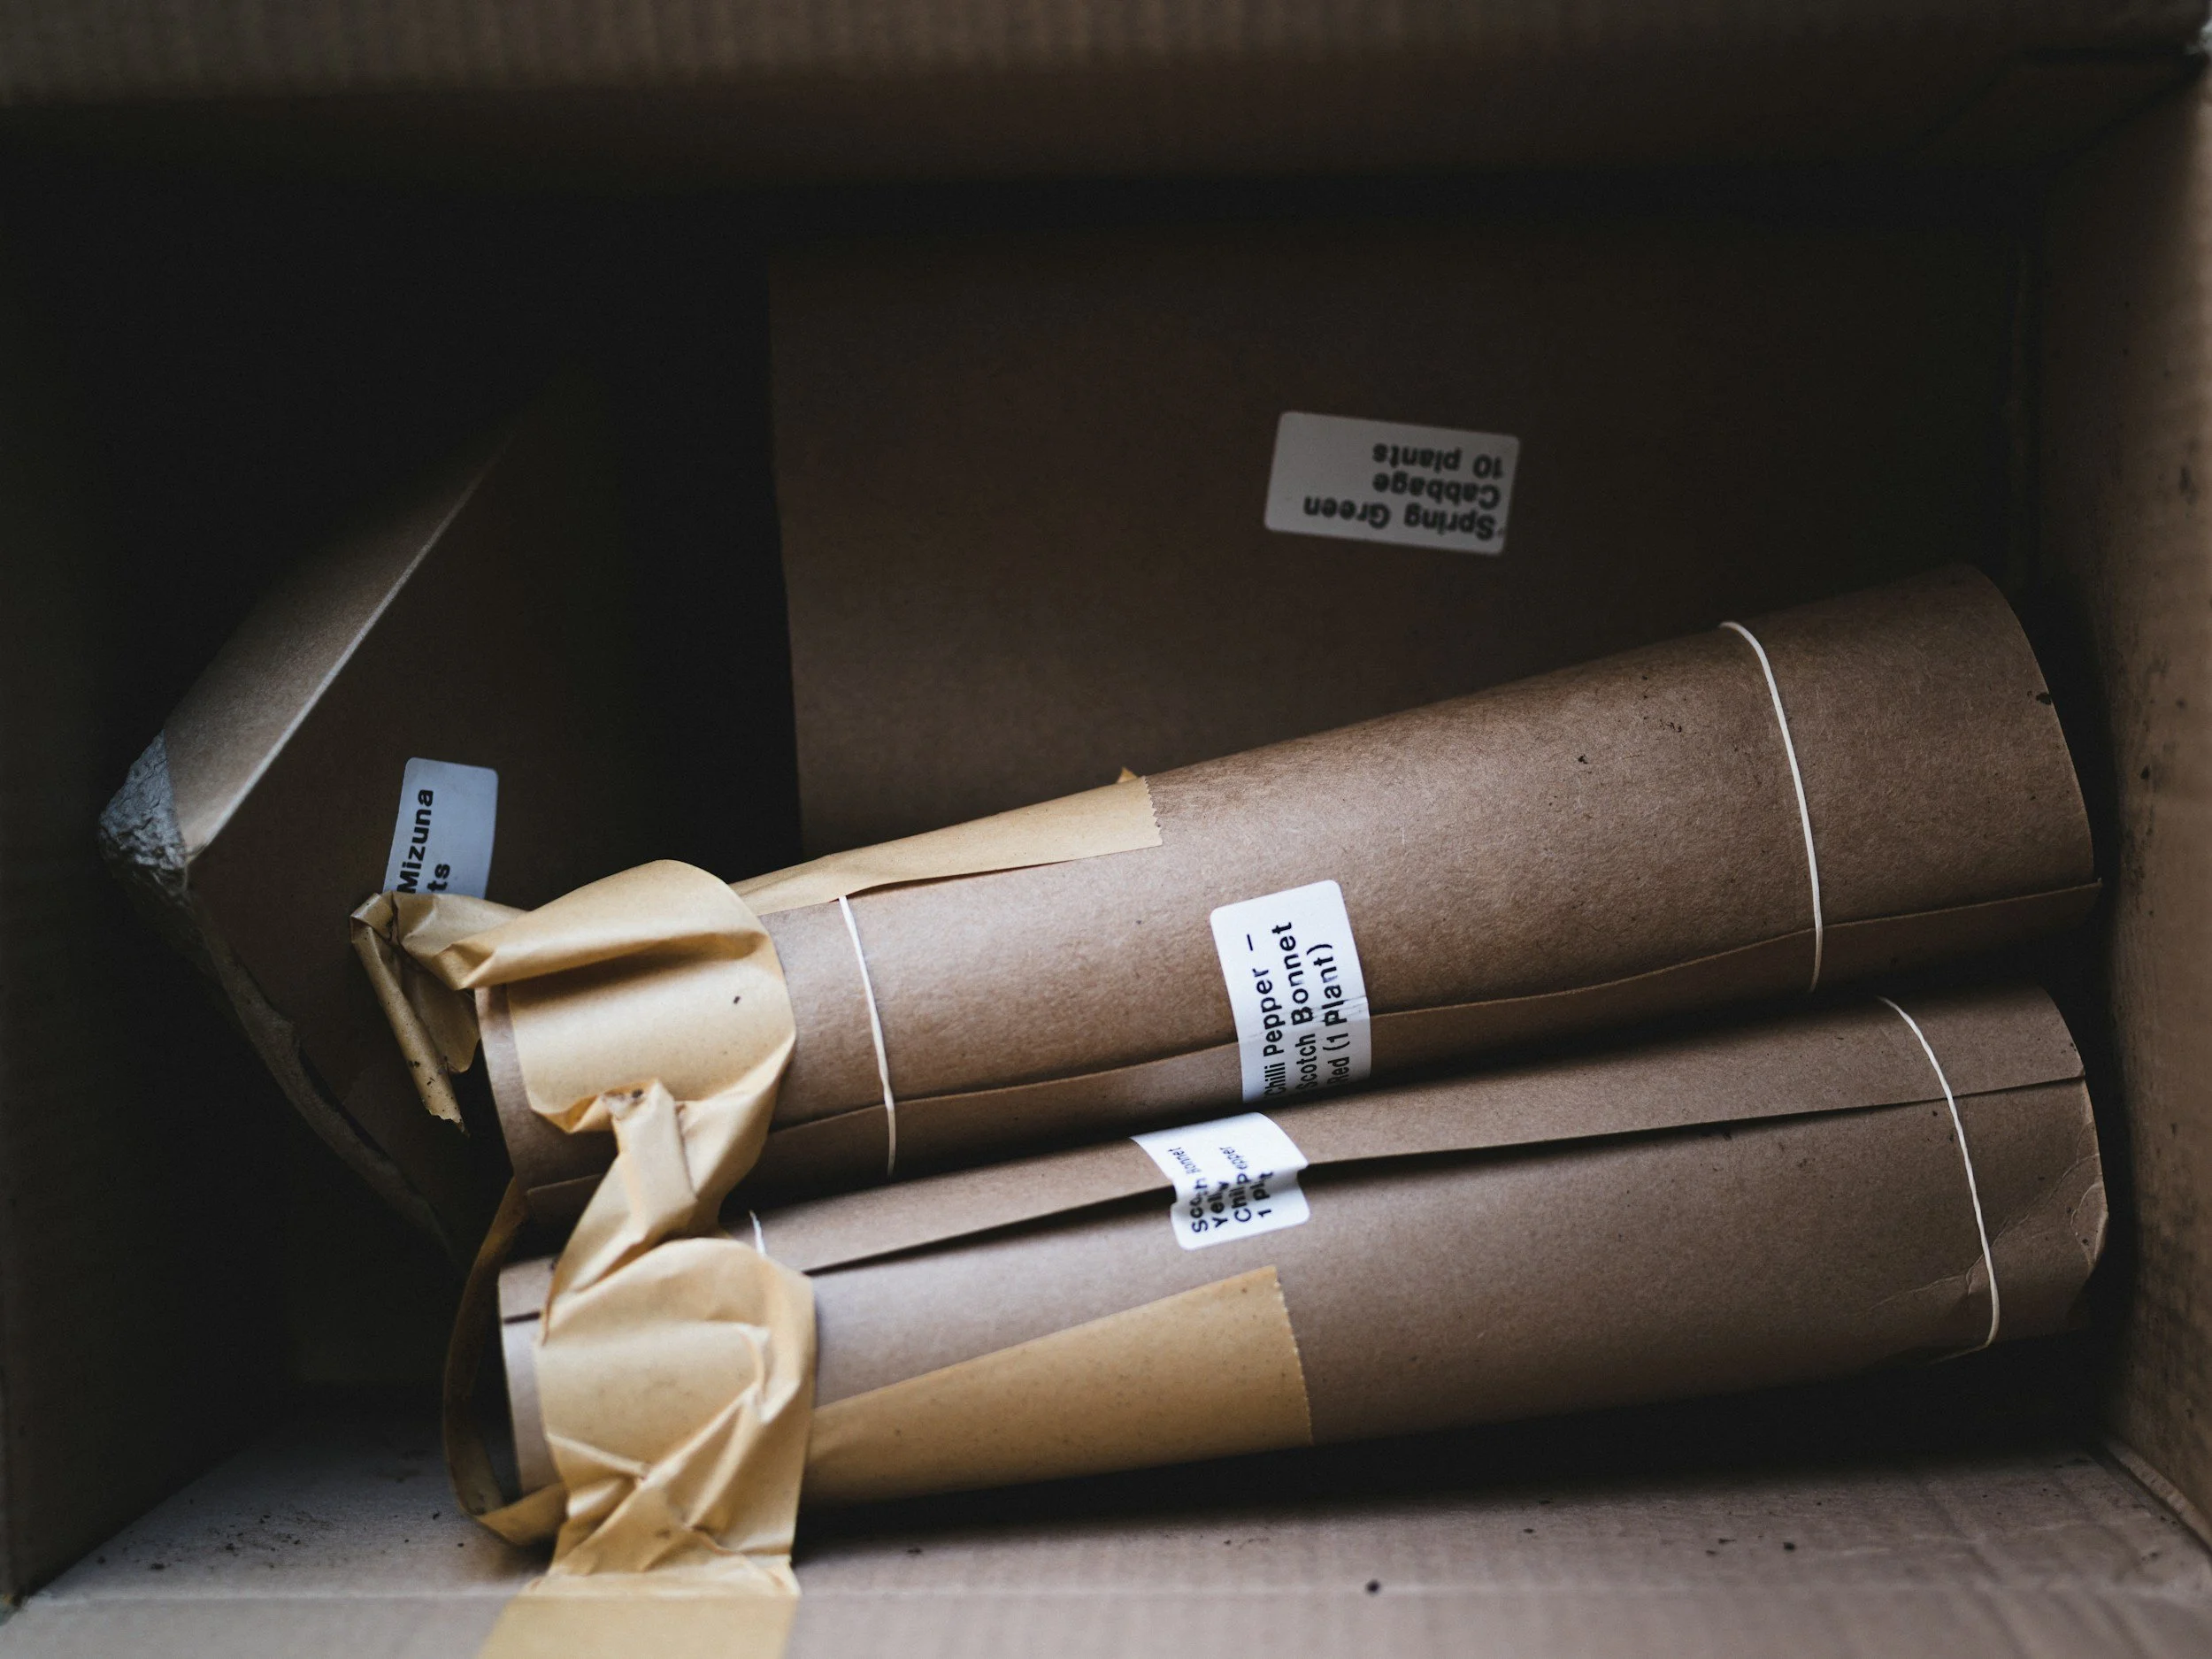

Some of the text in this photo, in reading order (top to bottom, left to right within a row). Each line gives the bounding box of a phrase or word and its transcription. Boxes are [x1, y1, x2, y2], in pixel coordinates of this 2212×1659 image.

[1372, 444, 1503, 480] 10 plants
[1372, 472, 1500, 509] Cabbage
[1303, 496, 1495, 541] Spring Green
[396, 789, 434, 893] Mizuna
[1271, 922, 1313, 1025] Bonnet
[1307, 943, 1348, 1025] Plant)
[1251, 968, 1286, 1056] Pepper
[1323, 1033, 1350, 1050] (1
[1256, 1208, 1271, 1218] 1
